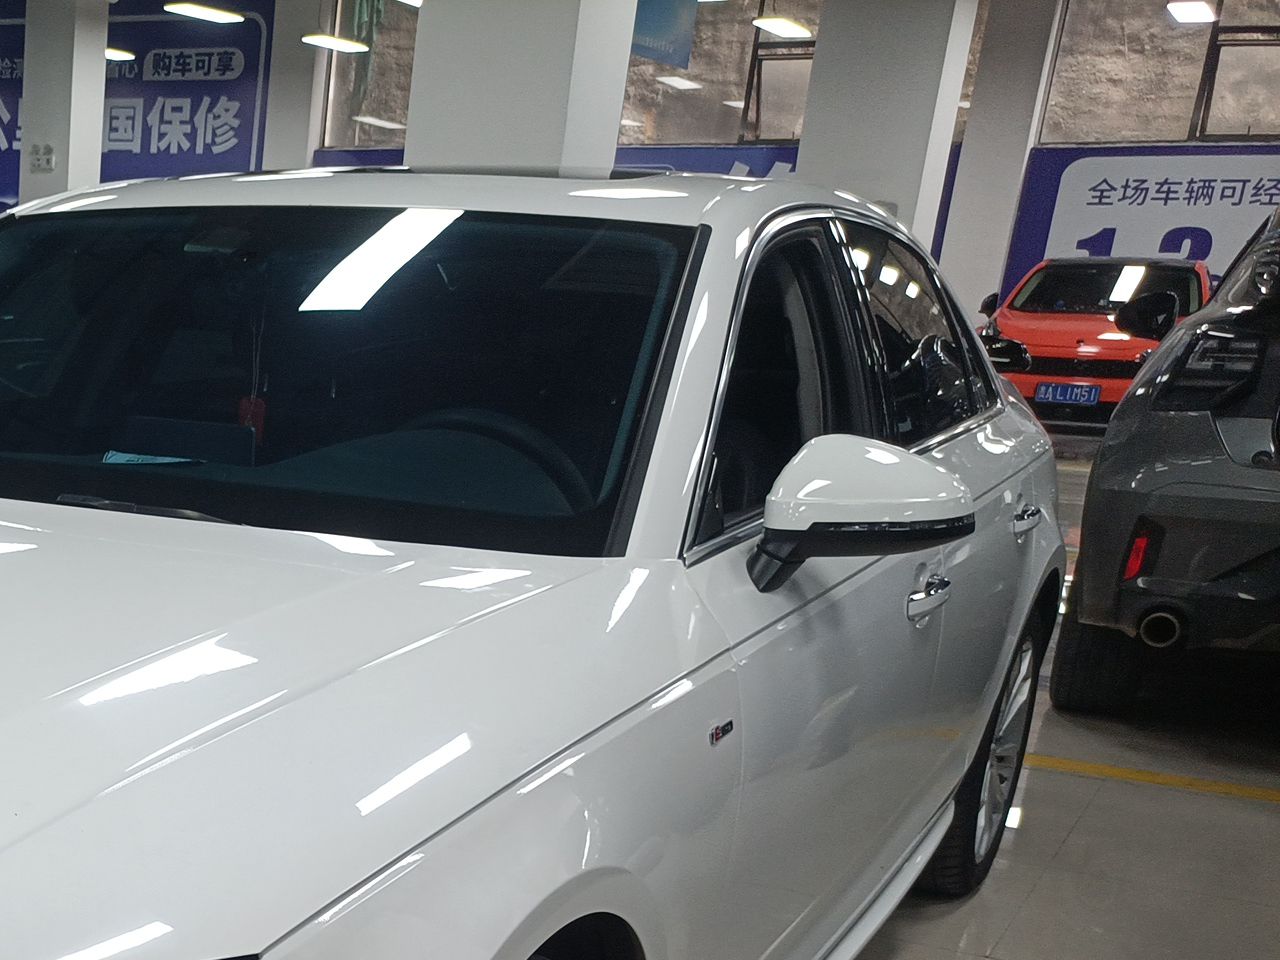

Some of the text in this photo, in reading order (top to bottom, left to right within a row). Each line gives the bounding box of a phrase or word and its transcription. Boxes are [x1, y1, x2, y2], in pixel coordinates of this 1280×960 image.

[151, 52, 236, 77] 购车可享
[1086, 177, 1280, 207] 全场车辆可经
